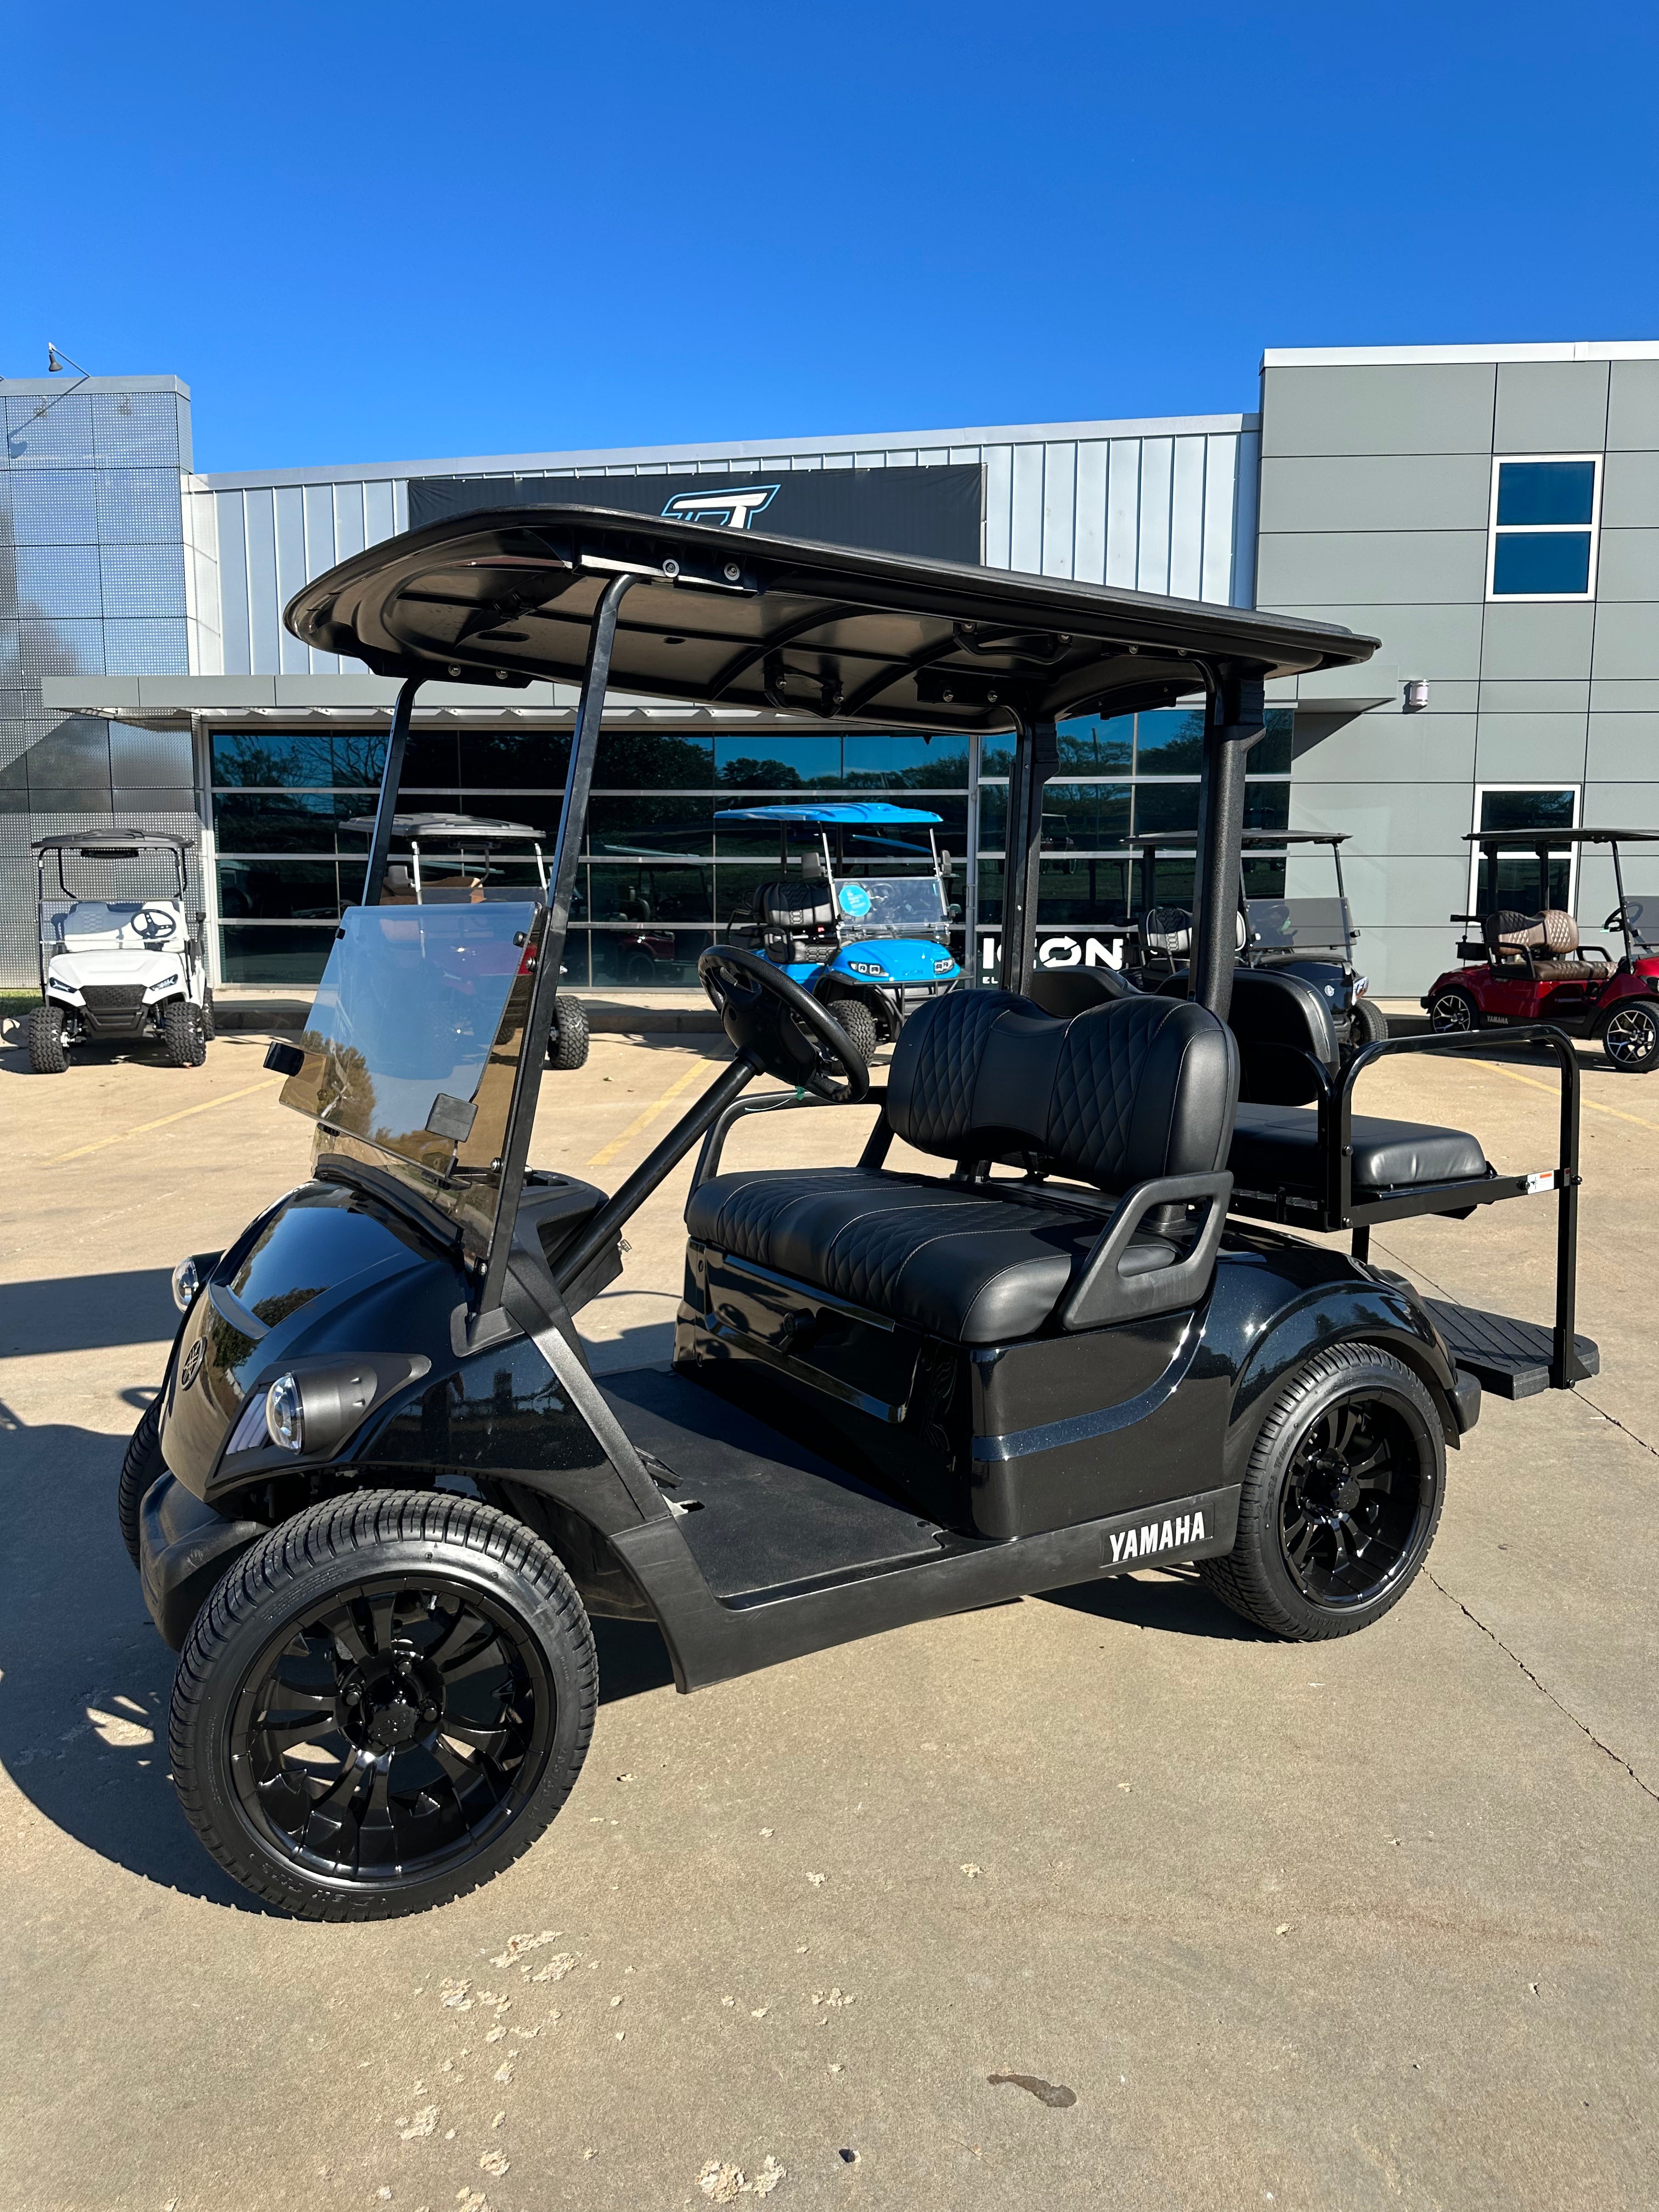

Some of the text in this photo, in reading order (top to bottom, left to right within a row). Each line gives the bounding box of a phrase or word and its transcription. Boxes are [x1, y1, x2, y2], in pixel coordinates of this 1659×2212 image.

[983, 935, 1124, 970] ION
[1487, 1015, 1509, 1025] YAMAHA
[1109, 1511, 1205, 1562] YAMAHA
